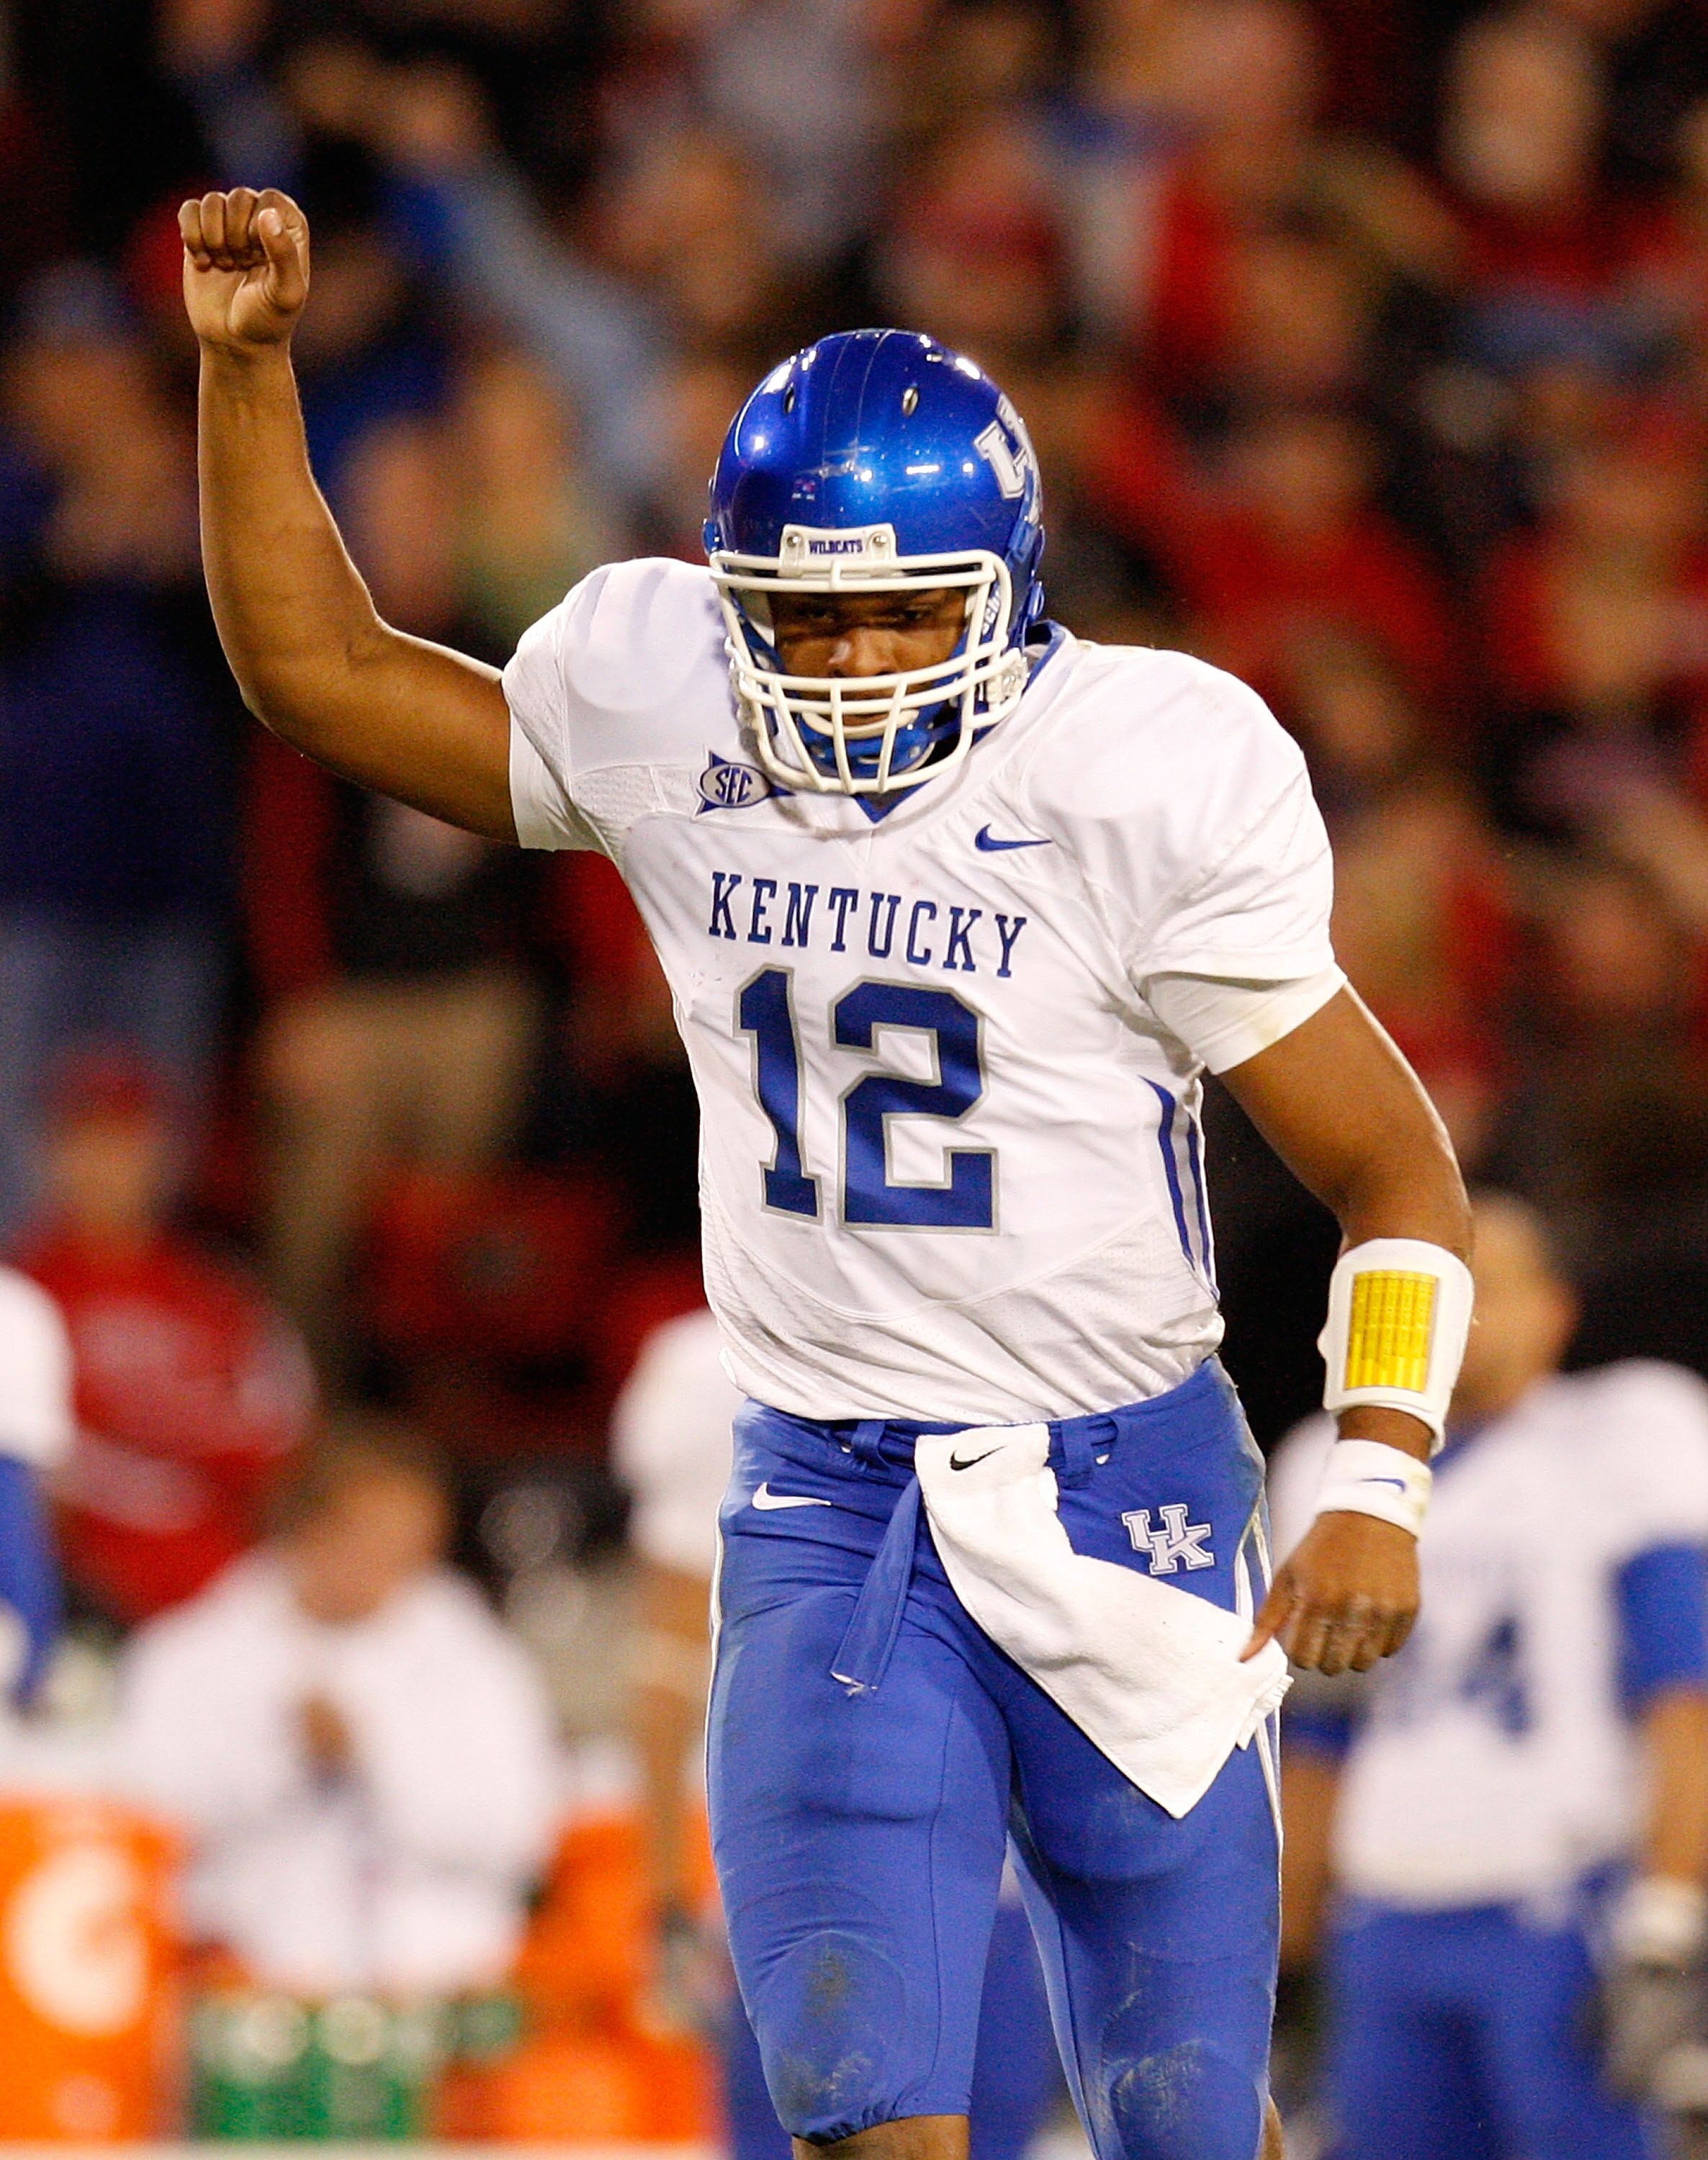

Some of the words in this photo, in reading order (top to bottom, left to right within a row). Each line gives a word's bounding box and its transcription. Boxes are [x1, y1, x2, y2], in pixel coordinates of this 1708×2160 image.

[809, 539, 863, 554] WILDCATS
[714, 765, 752, 804] SEC
[708, 871, 1028, 978] KENTUCKY
[733, 963, 999, 1235] 12
[1121, 1503, 1215, 1575] UK
